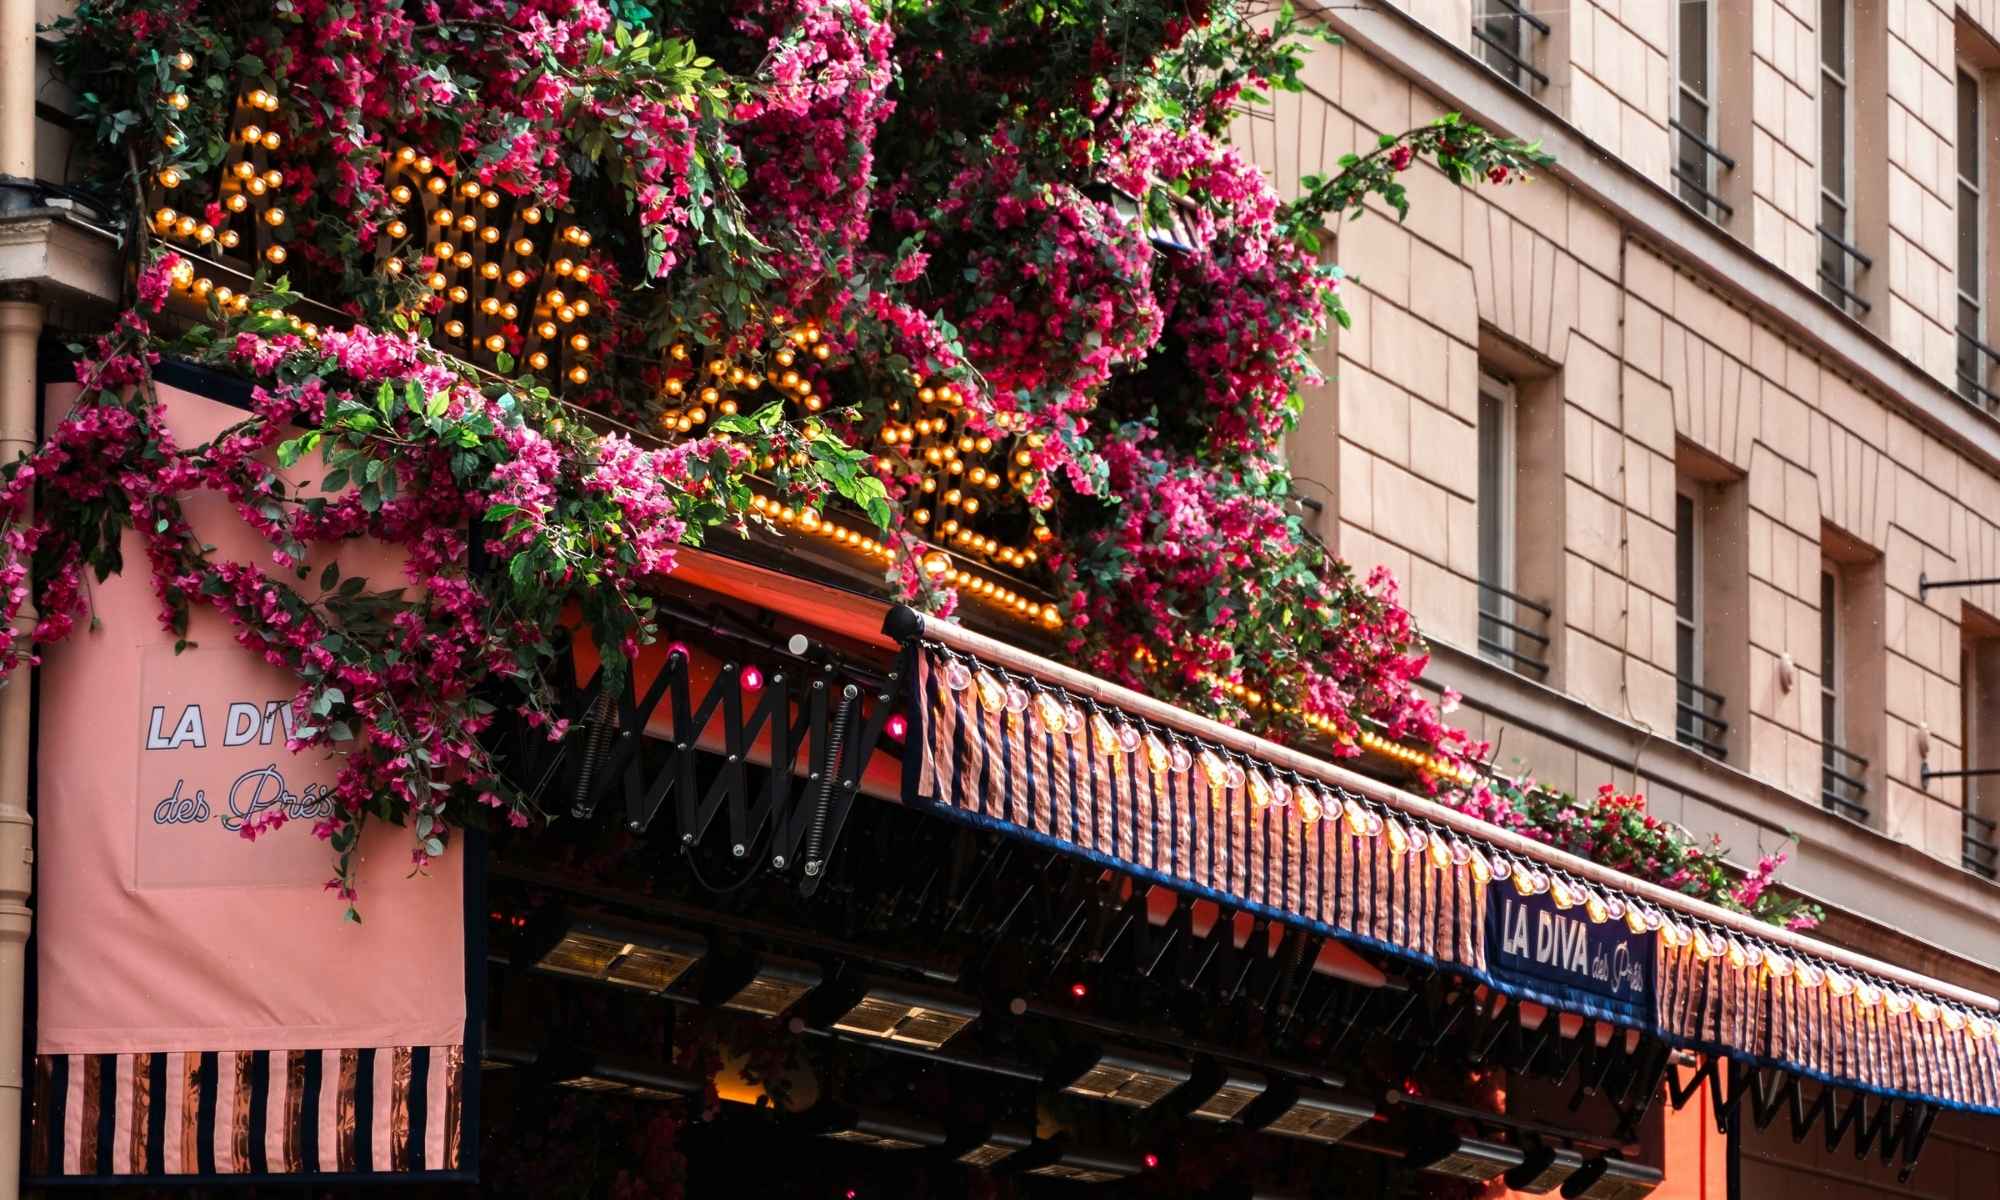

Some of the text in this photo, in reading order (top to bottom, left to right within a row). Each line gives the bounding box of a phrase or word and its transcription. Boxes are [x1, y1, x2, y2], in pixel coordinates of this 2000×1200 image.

[145, 700, 296, 750] LA DI
[154, 763, 334, 831] des Prés
[1503, 899, 1529, 959] LA
[1536, 909, 1588, 976] DIVA
